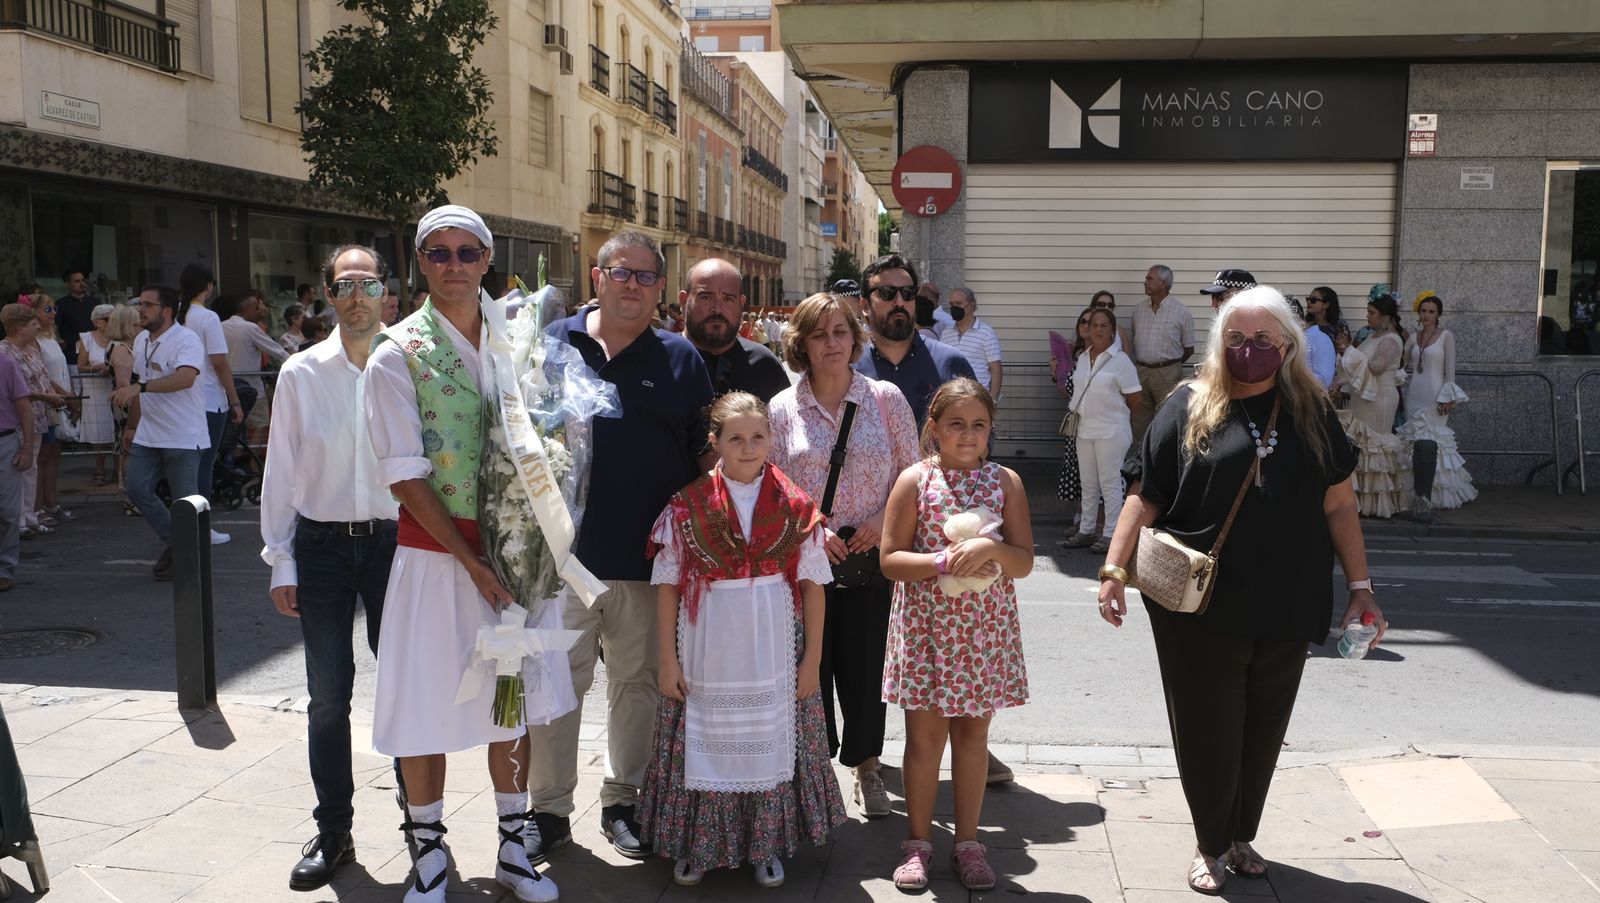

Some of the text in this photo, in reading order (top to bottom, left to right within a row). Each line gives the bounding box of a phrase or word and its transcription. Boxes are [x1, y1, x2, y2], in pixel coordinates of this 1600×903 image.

[1142, 87, 1324, 111] MAÑAS CANO
[1141, 114, 1323, 128] INMOBILIARIA
